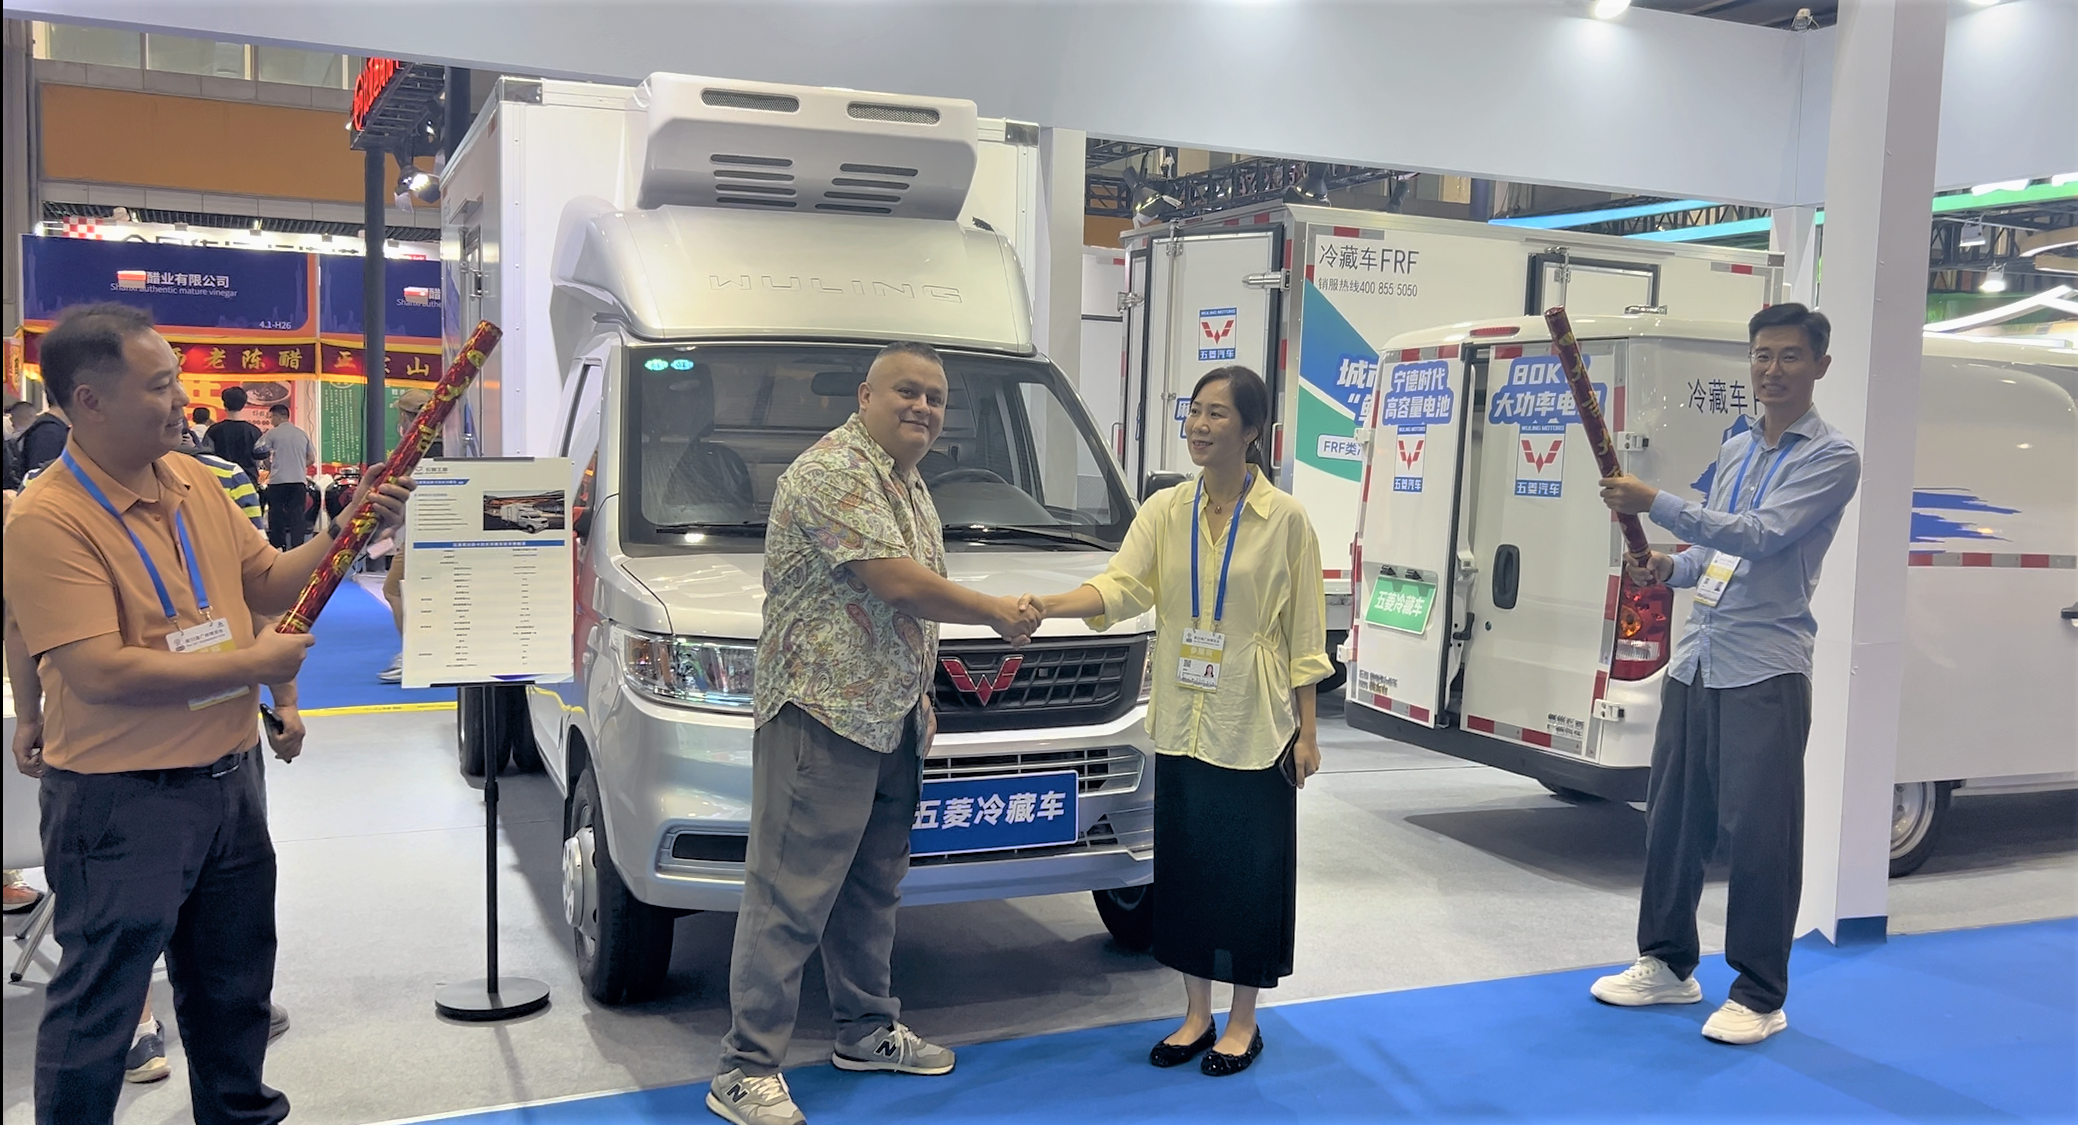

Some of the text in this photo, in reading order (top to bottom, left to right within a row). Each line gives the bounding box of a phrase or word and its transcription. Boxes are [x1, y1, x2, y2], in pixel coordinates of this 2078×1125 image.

[1319, 243, 1419, 274] 冷藏车FRF
[179, 286, 208, 296] mature
[209, 288, 238, 298] vinegar
[708, 275, 963, 303] WULING
[1378, 281, 1394, 296] 855
[1397, 283, 1418, 297] 5050
[259, 320, 292, 330] 4.1-H26
[1393, 367, 1446, 393] 宁德时代
[1512, 363, 1569, 385] 80K
[1384, 394, 1451, 419] 高容量电池
[1493, 390, 1602, 417] 大功率电
[1516, 481, 1560, 496] 五菱汽车
[1374, 590, 1425, 618] 五菱冷藏车
[911, 789, 1067, 830] 五菱冷藏车
[873, 1039, 897, 1058] N
[726, 1083, 749, 1103] N
